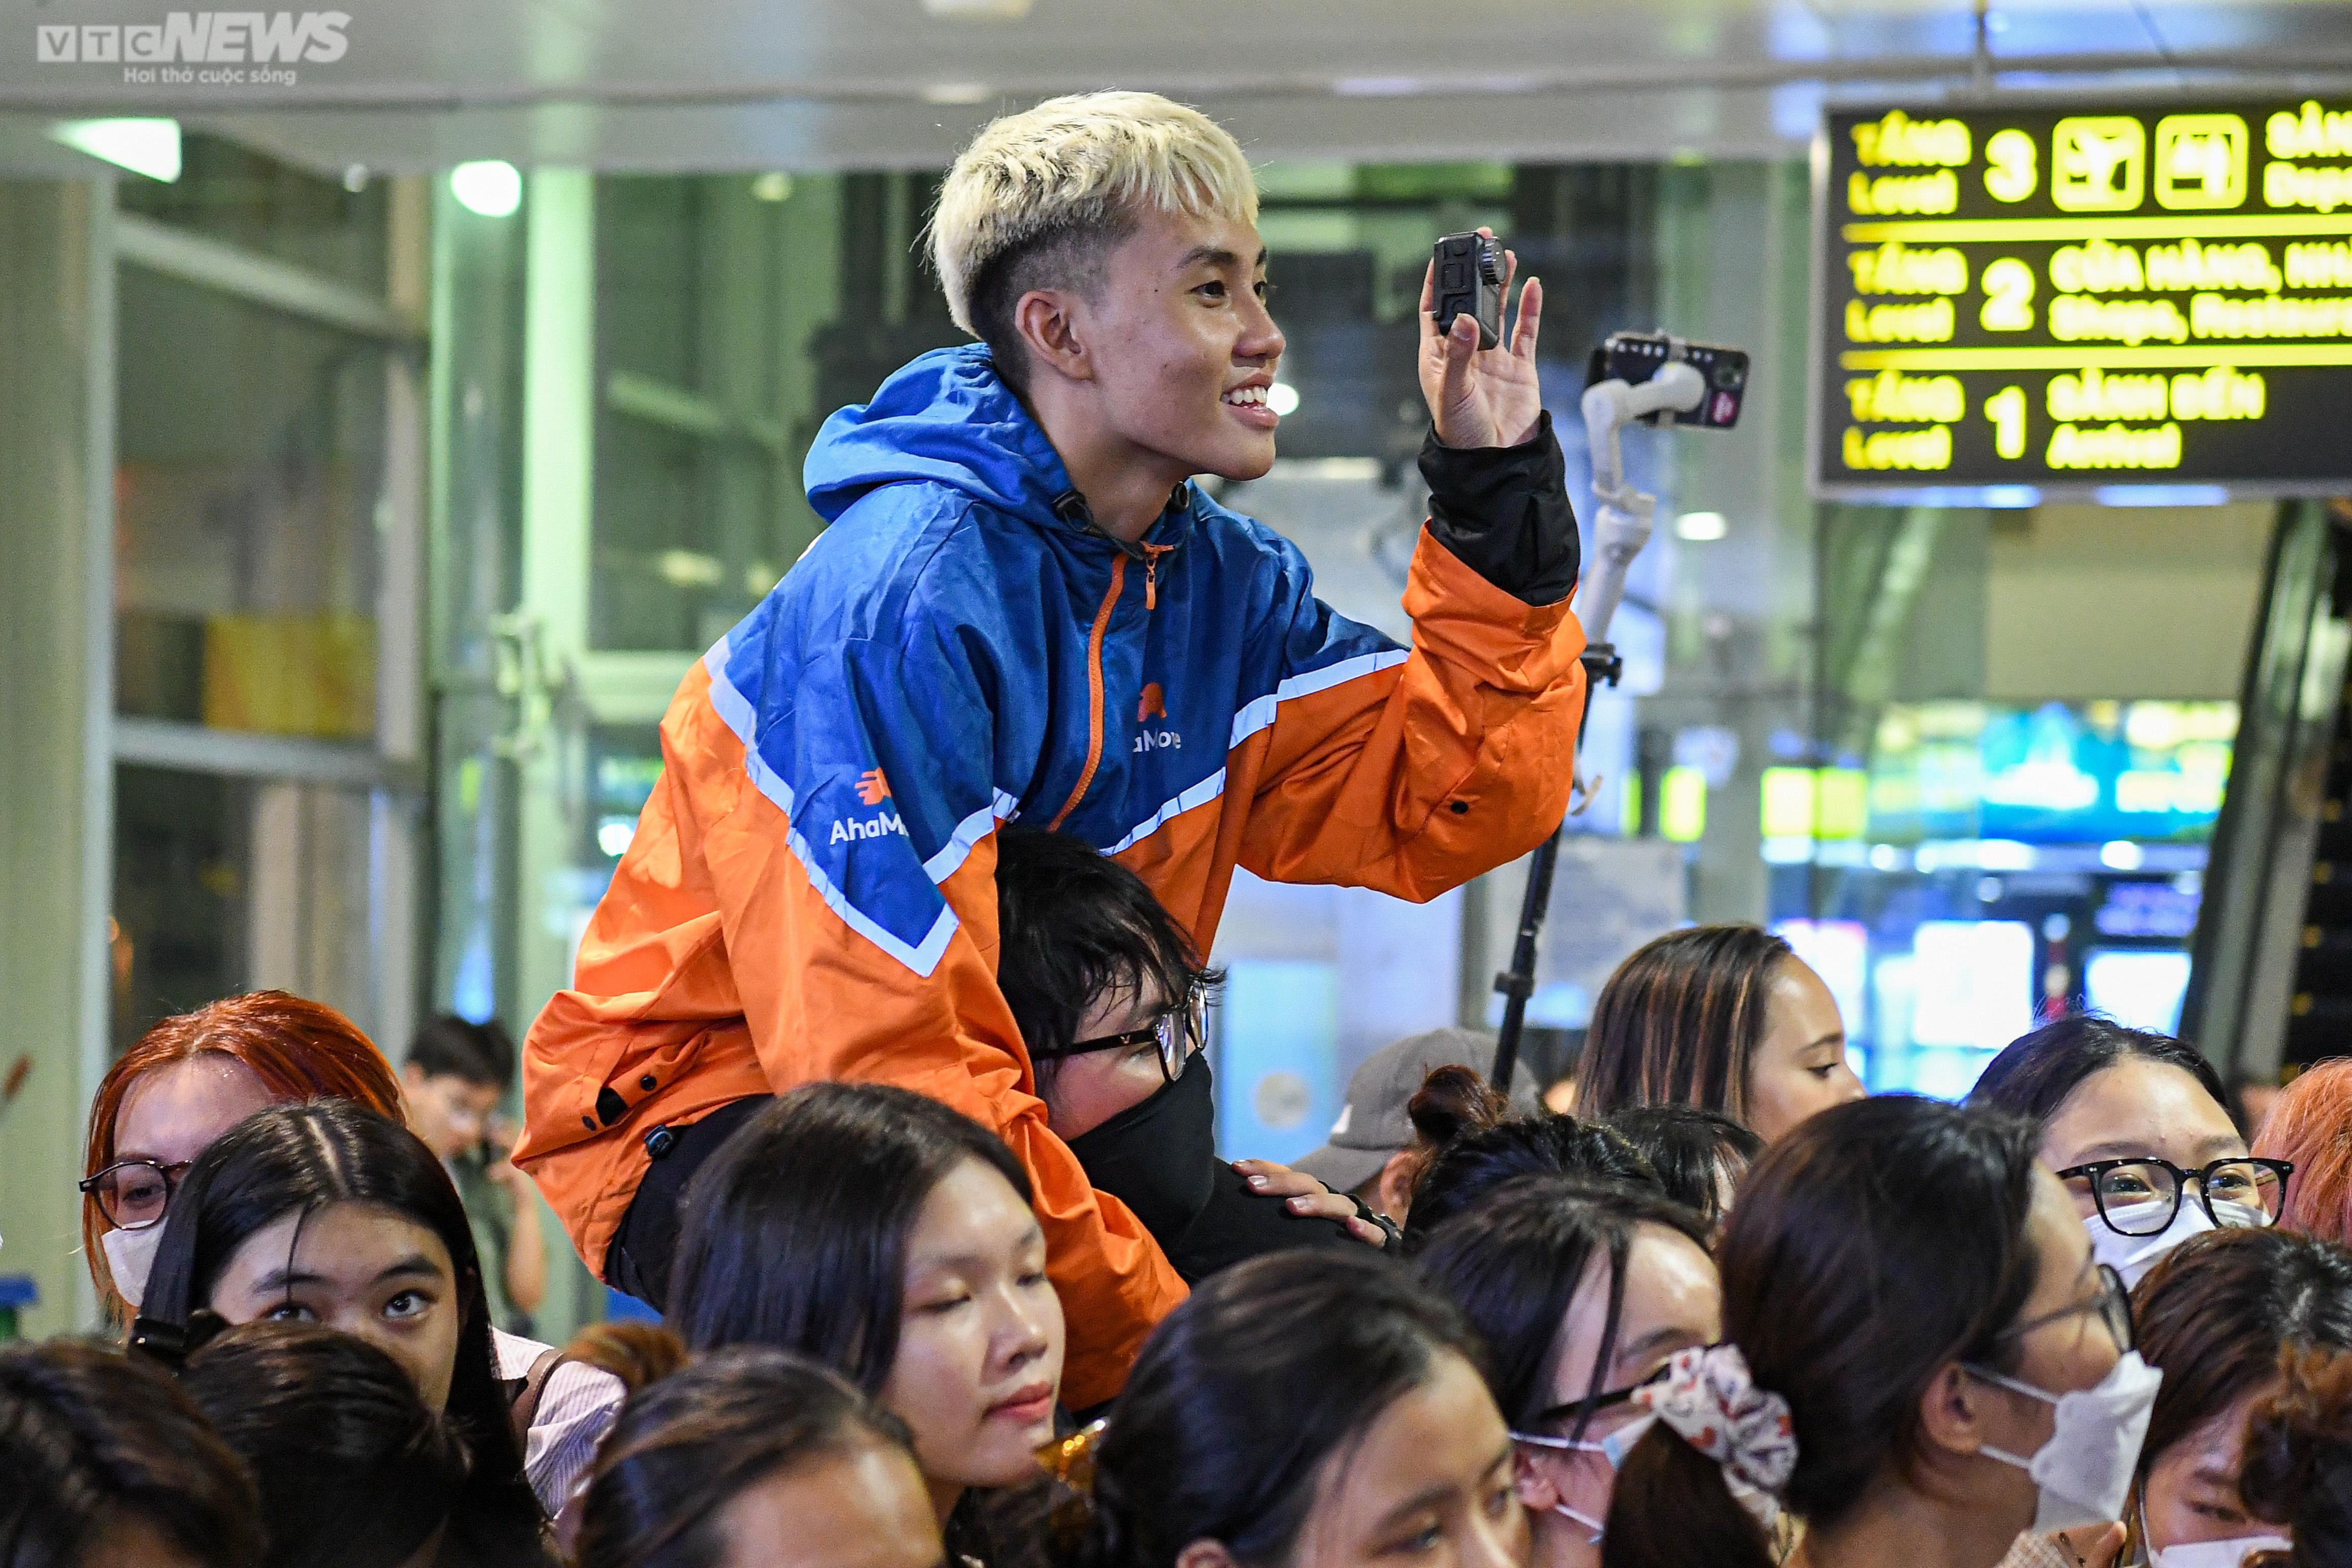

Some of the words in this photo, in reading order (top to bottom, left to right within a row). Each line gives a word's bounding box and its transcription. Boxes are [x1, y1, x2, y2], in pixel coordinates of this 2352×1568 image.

[1983, 128, 2037, 203] 3
[1980, 257, 2035, 331] 2
[1984, 385, 2026, 459] 1
[830, 812, 909, 845] AhaM
